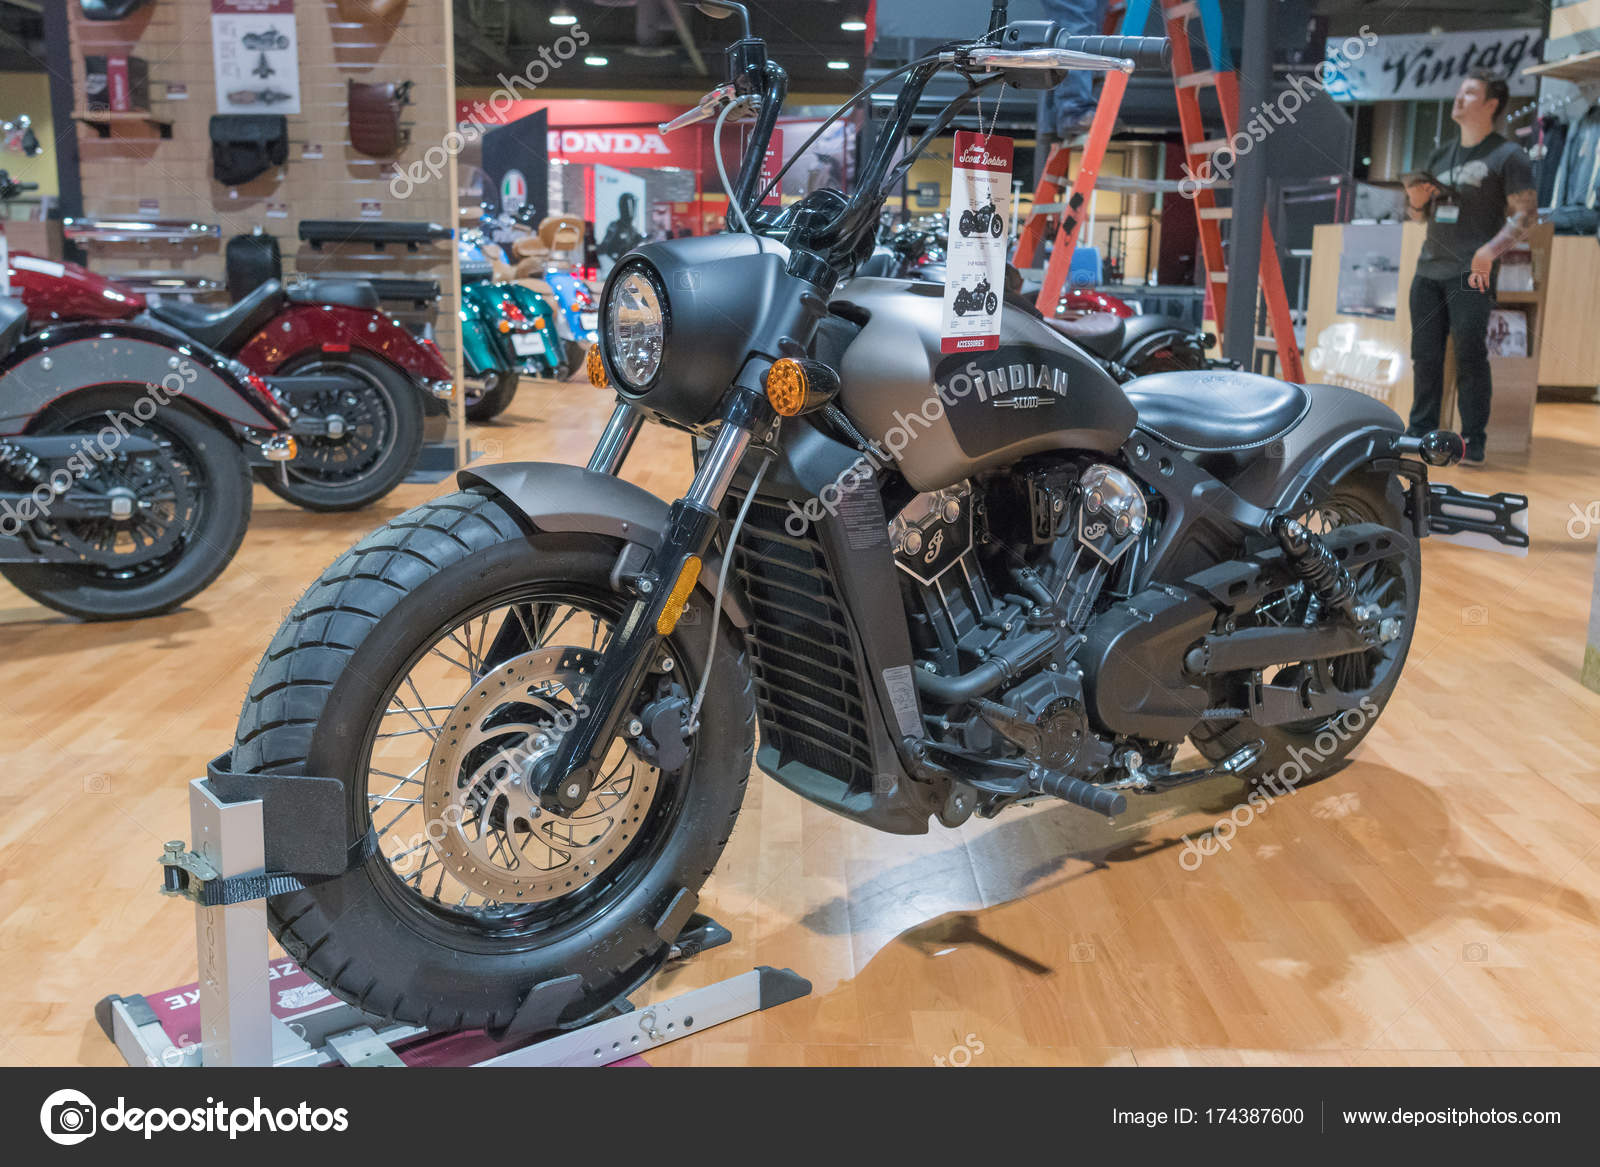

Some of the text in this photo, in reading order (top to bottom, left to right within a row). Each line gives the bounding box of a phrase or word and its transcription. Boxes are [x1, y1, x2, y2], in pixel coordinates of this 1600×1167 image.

[959, 149, 1008, 167] Scout Bobber
[974, 363, 1069, 402] INDIAN
